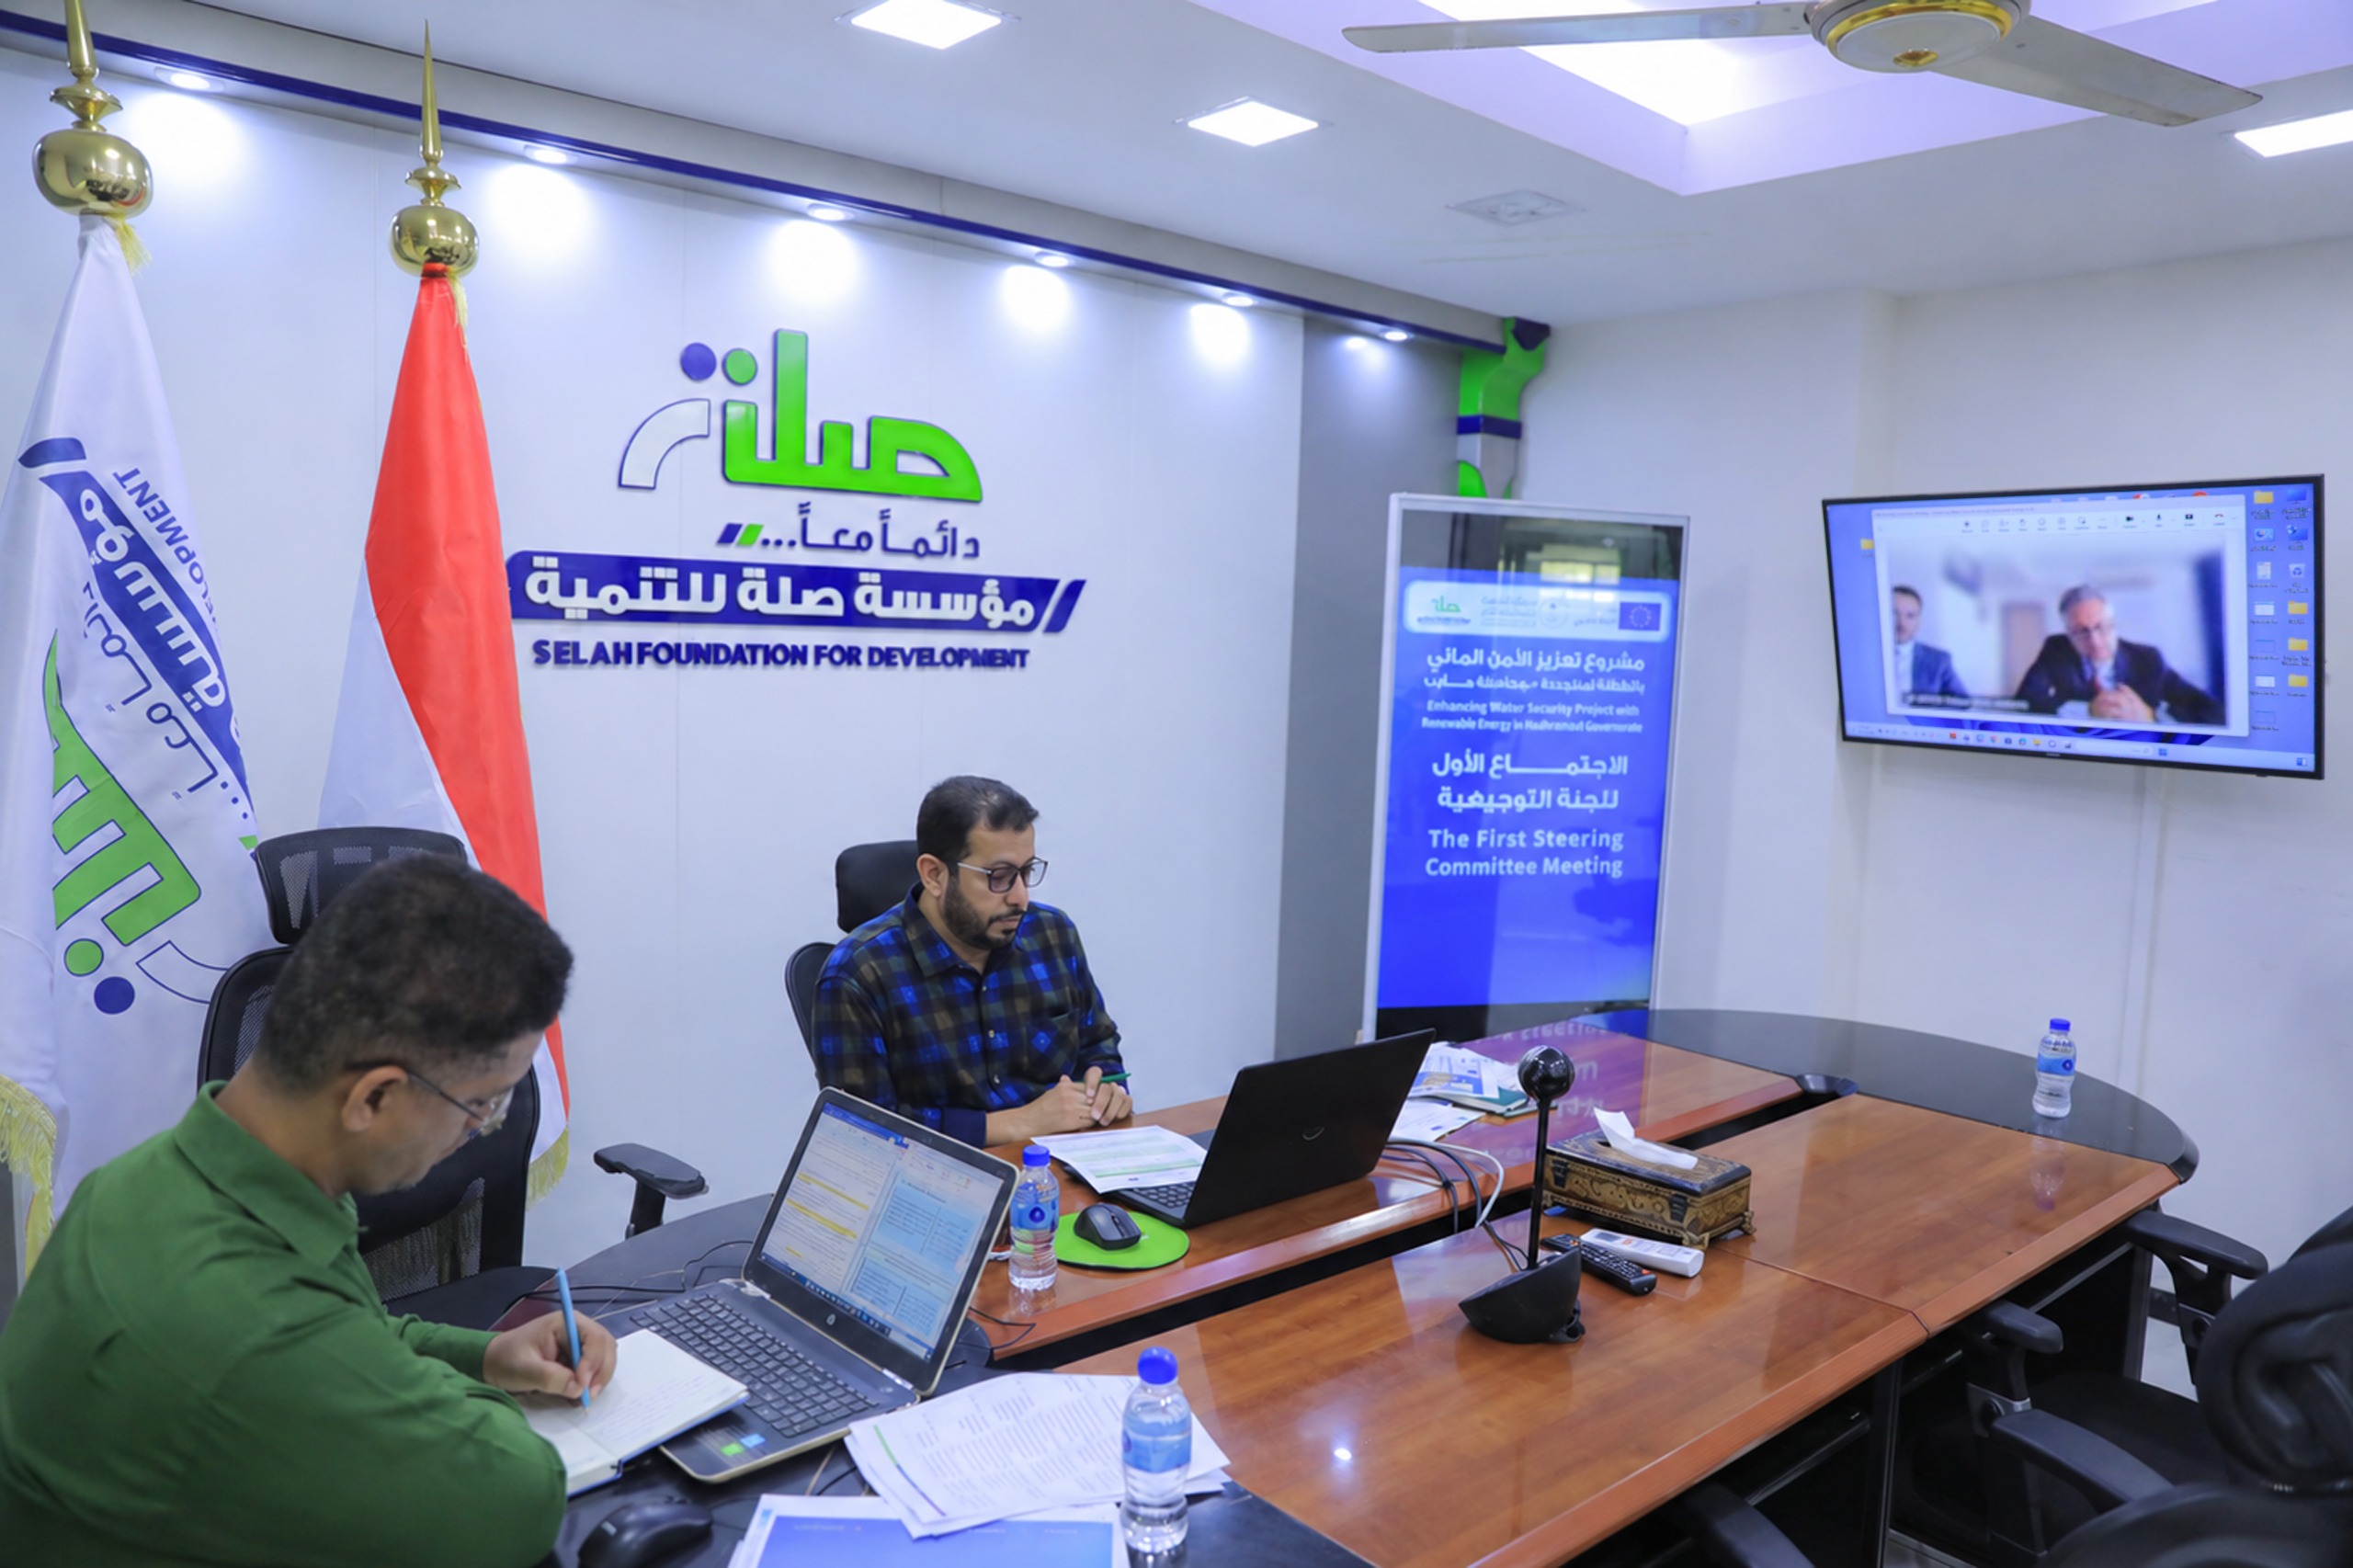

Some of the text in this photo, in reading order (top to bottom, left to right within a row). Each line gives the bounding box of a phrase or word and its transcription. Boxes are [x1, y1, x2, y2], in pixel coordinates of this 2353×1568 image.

[525, 555, 1035, 629] مؤسسة صلة للتنمية
[532, 640, 1030, 669] SELAH FOUNDATION FOR DEVELOPMENT
[1535, 651, 1582, 672] تعزيز
[1584, 650, 1645, 674] مشروع
[1427, 699, 1487, 715] Enhancing
[1574, 703, 1614, 718] Project
[1478, 718, 1512, 733] Energy
[1432, 748, 1484, 777] الأول
[1557, 788, 1619, 813] للجنة
[1428, 828, 1624, 852] The First Steering
[1426, 855, 1623, 879] Committee Meeting
